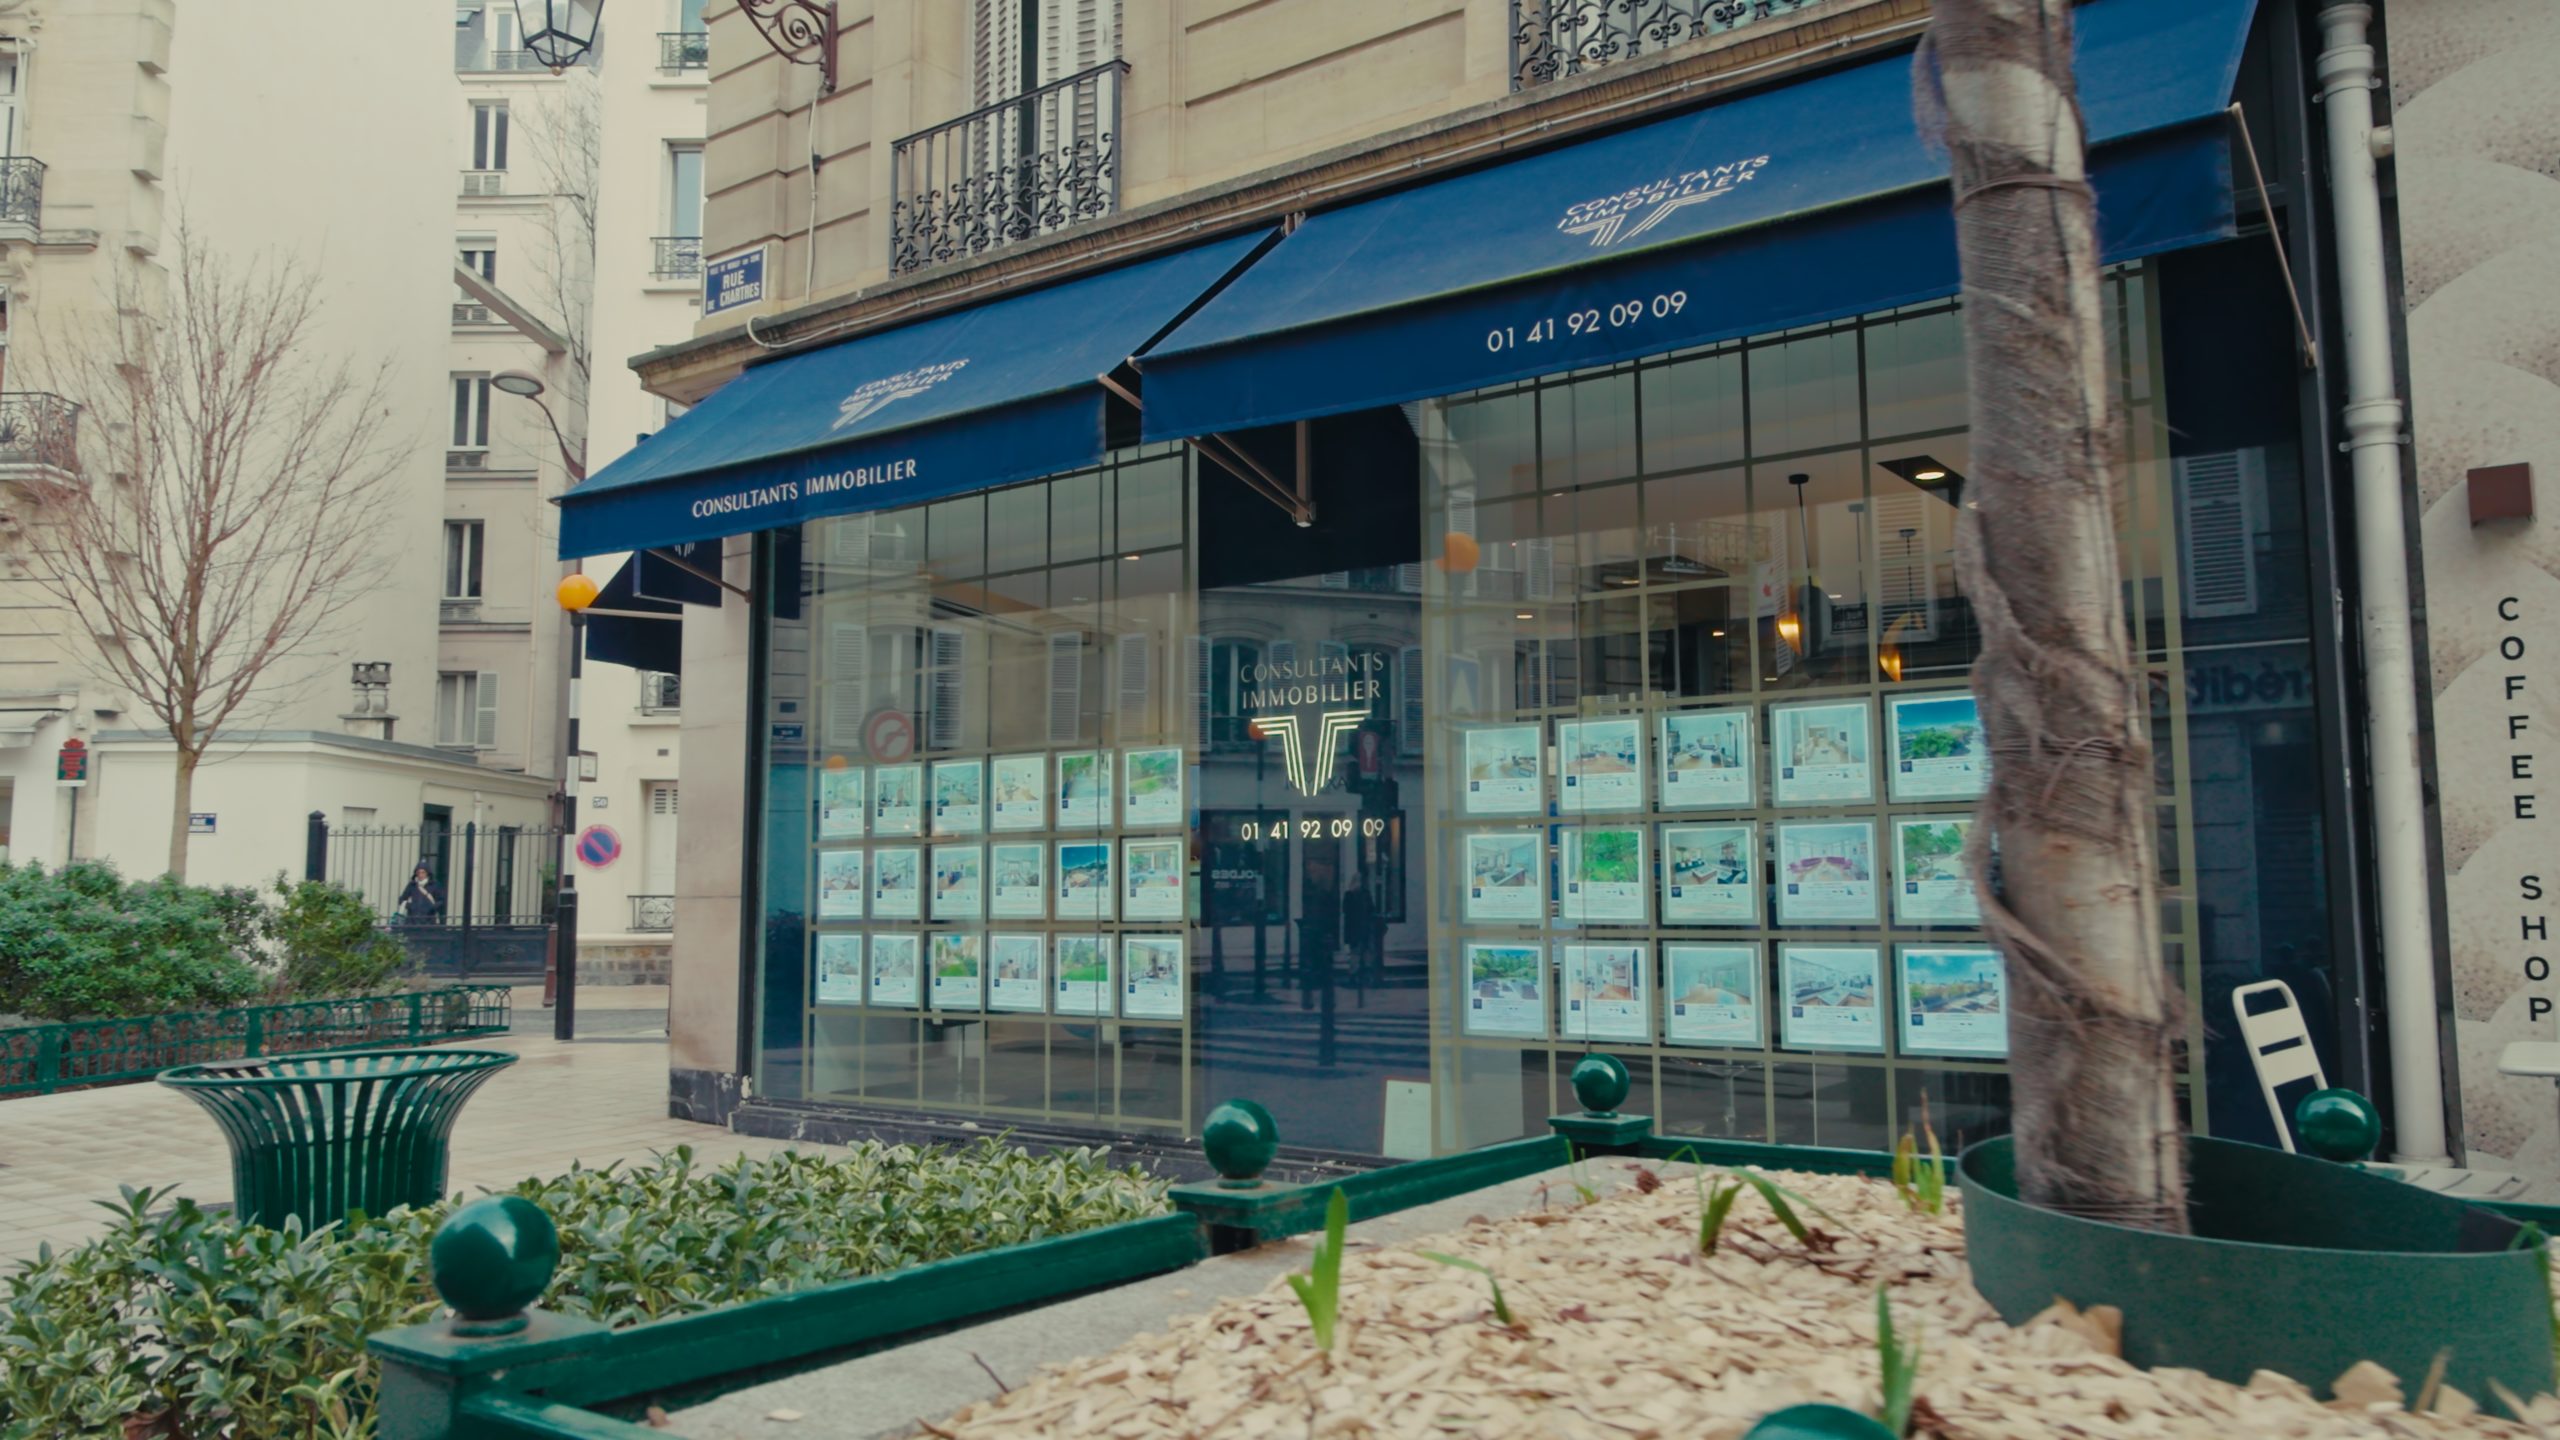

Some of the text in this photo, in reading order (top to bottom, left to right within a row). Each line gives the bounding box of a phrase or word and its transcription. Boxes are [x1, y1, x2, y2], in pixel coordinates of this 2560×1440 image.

[1557, 169, 1756, 230] IMMOBILIER
[1566, 154, 1770, 216] CONSULTANTS
[720, 281, 760, 307] CHARTRES
[722, 269, 745, 290] RUE
[1487, 290, 1687, 352] 01 41 92 09 09
[692, 458, 917, 518] CONSULTANTS IMMOBILIER
[1240, 651, 1384, 684] CONSULTANTS
[1242, 679, 1381, 710] IMMOBILIER
[2498, 596, 2537, 820] COFFEE
[1241, 818, 1385, 841] 01 41 92 09 09
[2519, 875, 2553, 1022] SHOP
